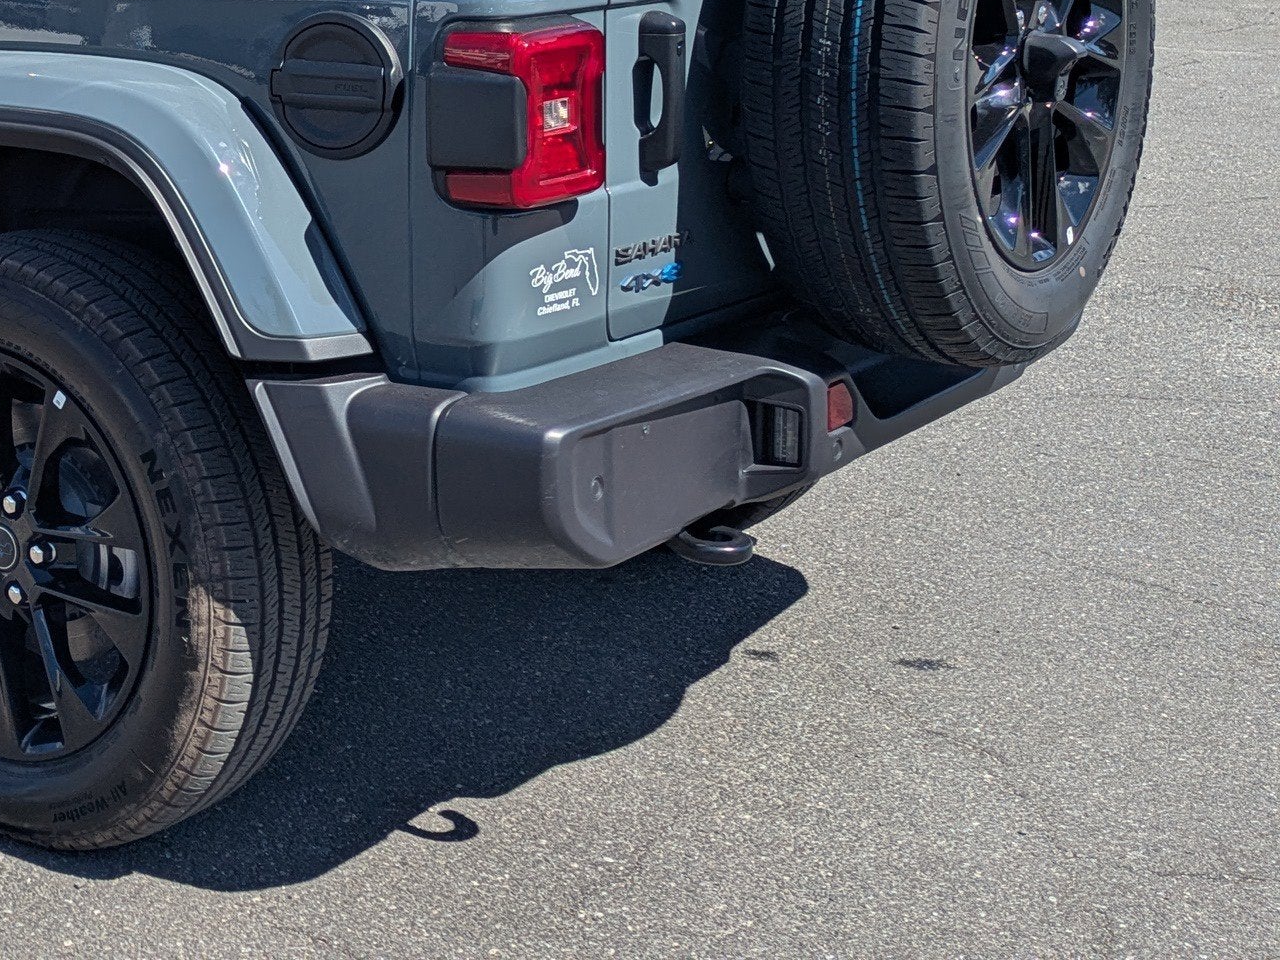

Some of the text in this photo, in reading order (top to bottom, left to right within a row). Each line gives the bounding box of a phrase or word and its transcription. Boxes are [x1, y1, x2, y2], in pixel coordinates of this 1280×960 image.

[529, 259, 582, 294] Big Bend
[544, 287, 577, 303] CHEVROLET
[571, 297, 581, 308] FL
[139, 448, 193, 629] NEXEN
